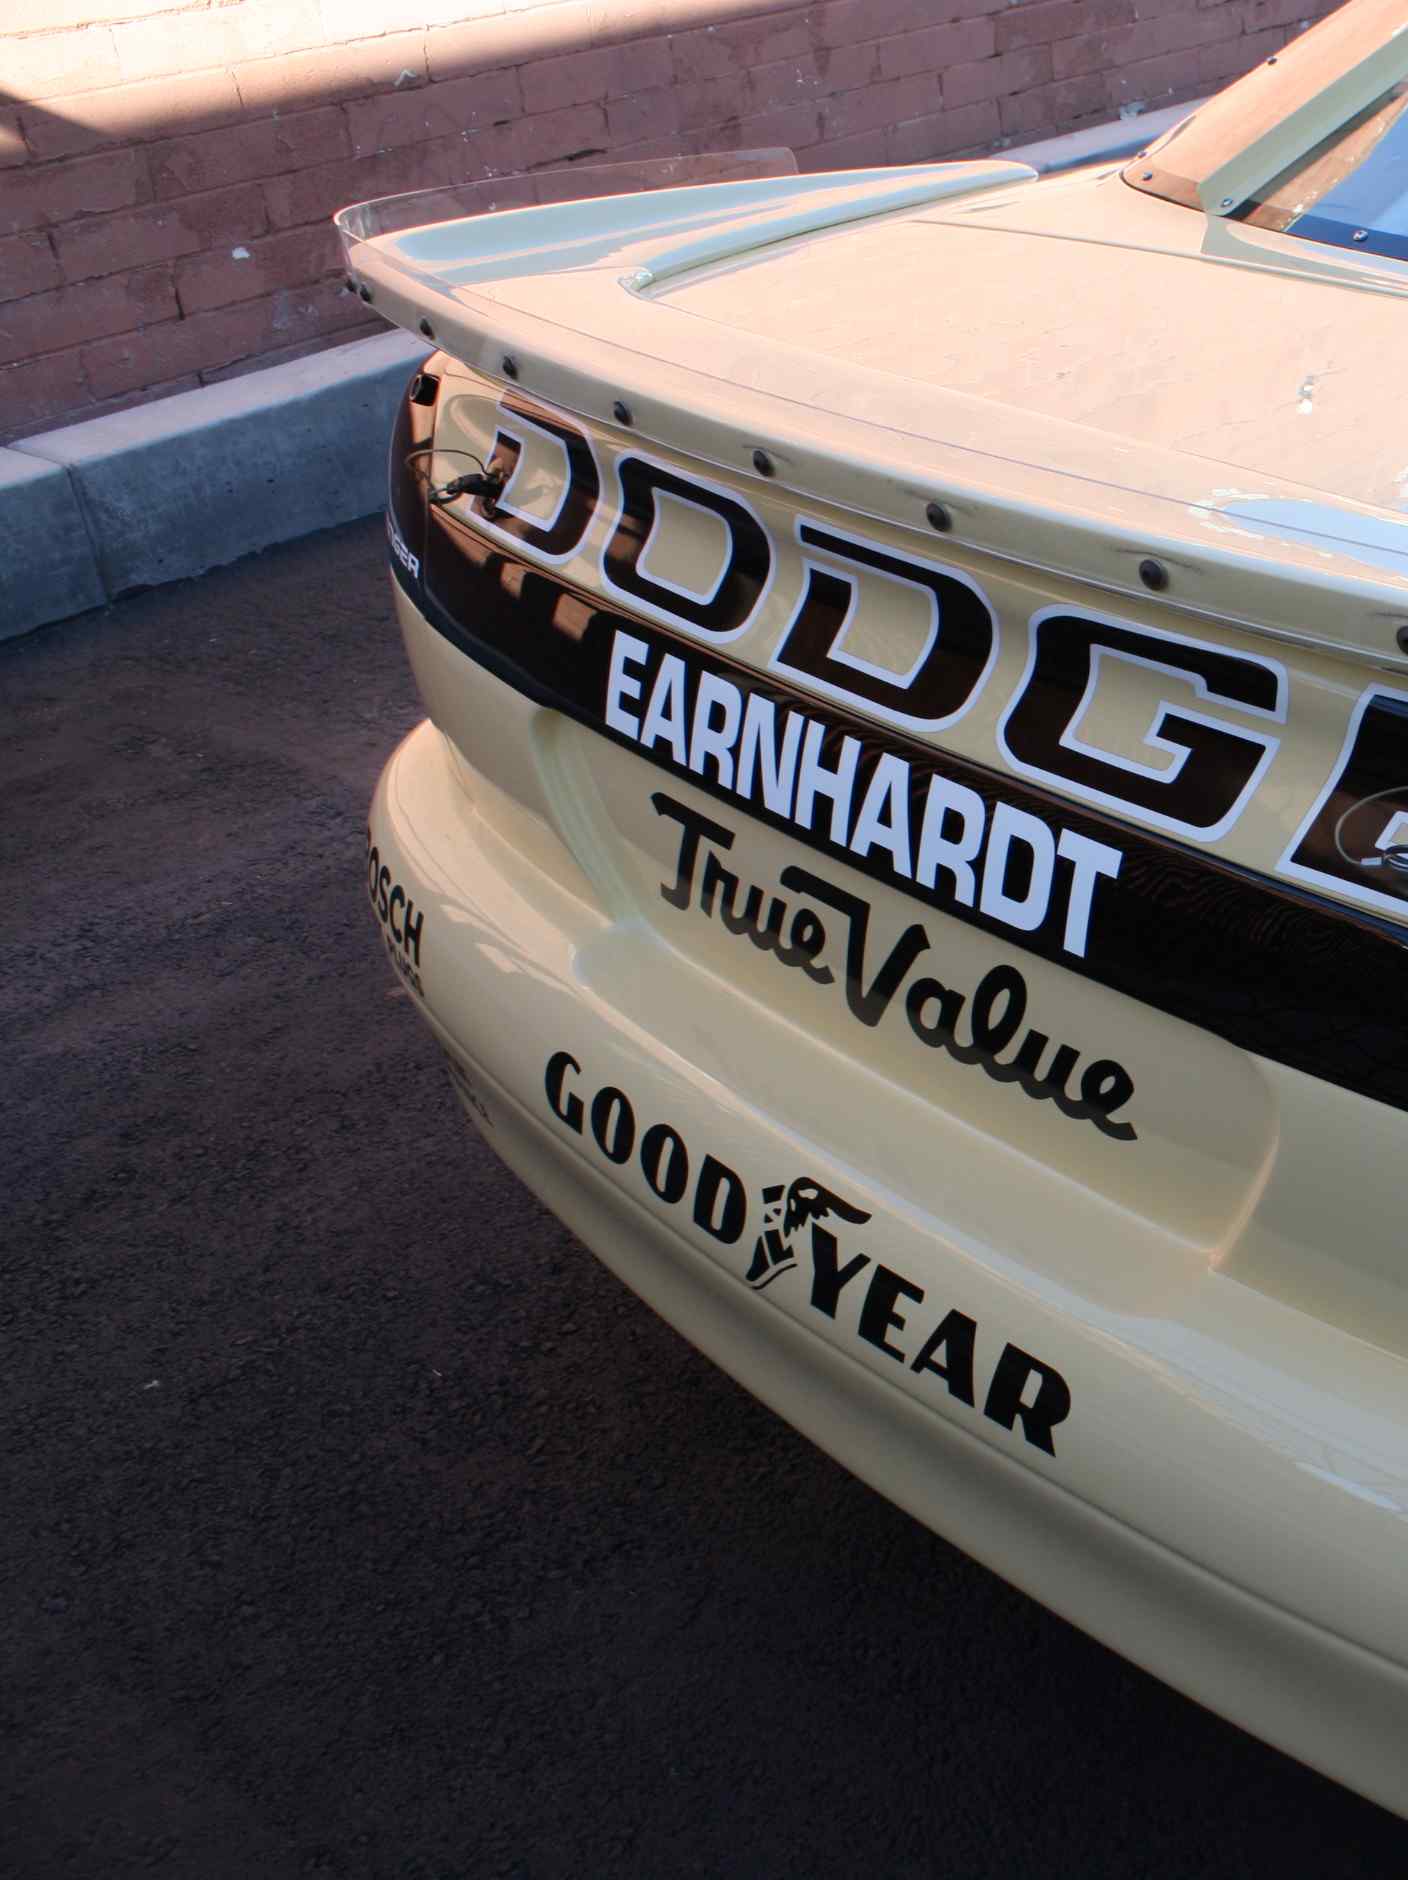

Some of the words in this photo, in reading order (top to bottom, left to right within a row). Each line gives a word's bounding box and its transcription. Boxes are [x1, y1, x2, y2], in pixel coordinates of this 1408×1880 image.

[367, 828, 424, 968] OSCH
[604, 628, 1123, 958] EARNHARDT
[651, 791, 835, 985] True
[779, 864, 1138, 1141] Value
